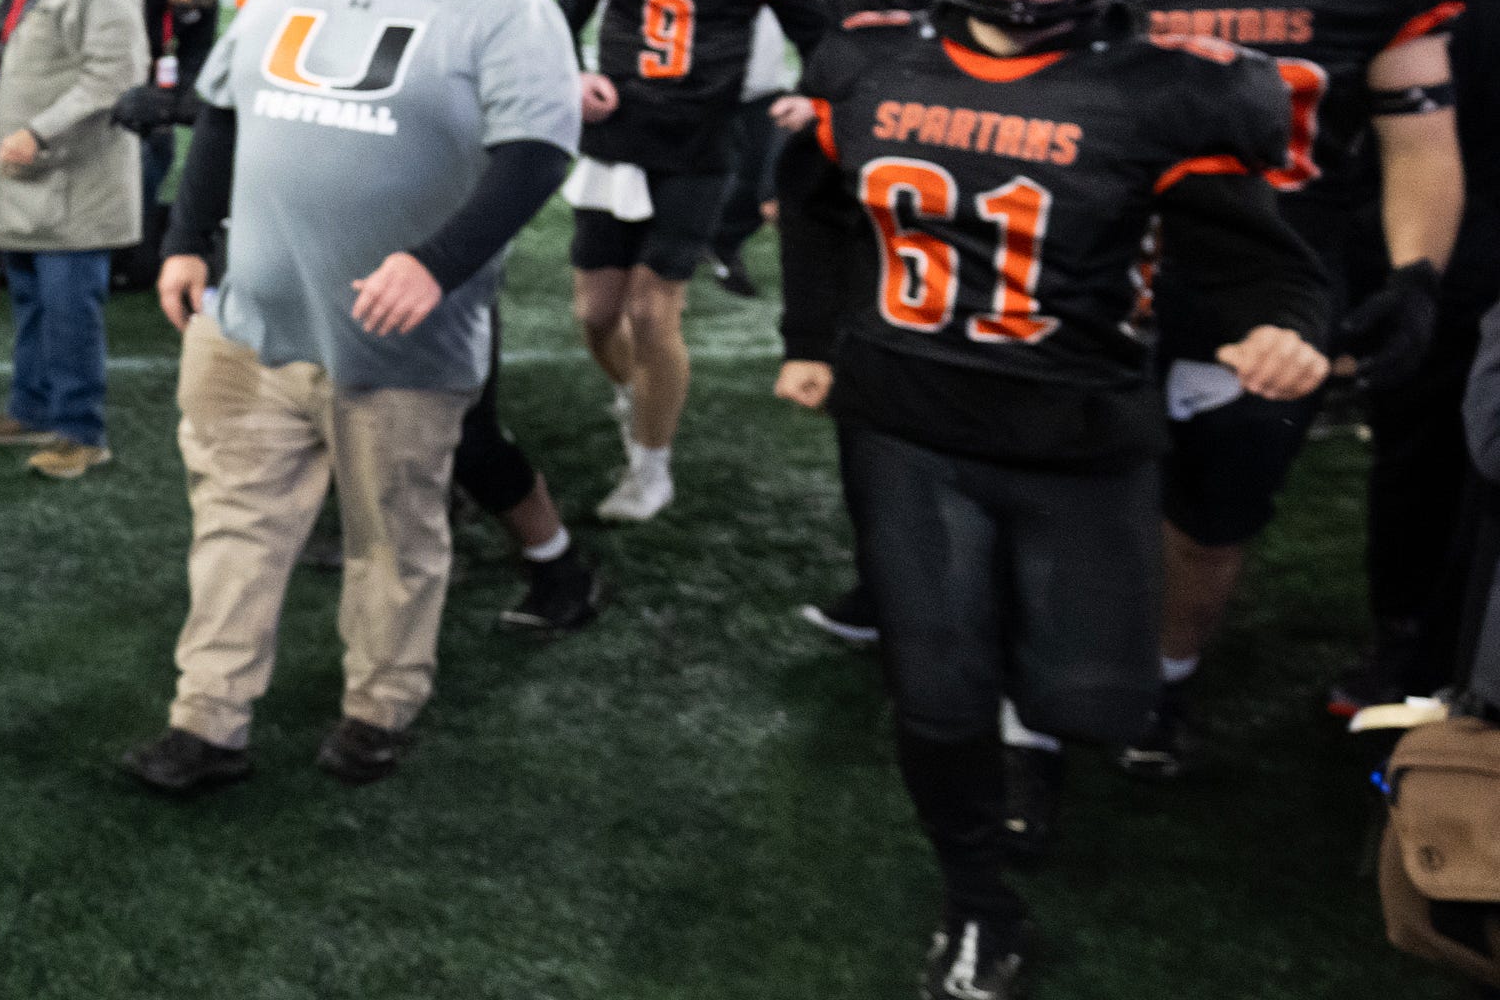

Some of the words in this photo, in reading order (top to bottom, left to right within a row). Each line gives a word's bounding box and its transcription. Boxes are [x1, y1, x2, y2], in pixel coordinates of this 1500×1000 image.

[254, 89, 398, 137] FOOTBALL
[871, 99, 1084, 167] SPARTANS
[857, 155, 1062, 344] 61
